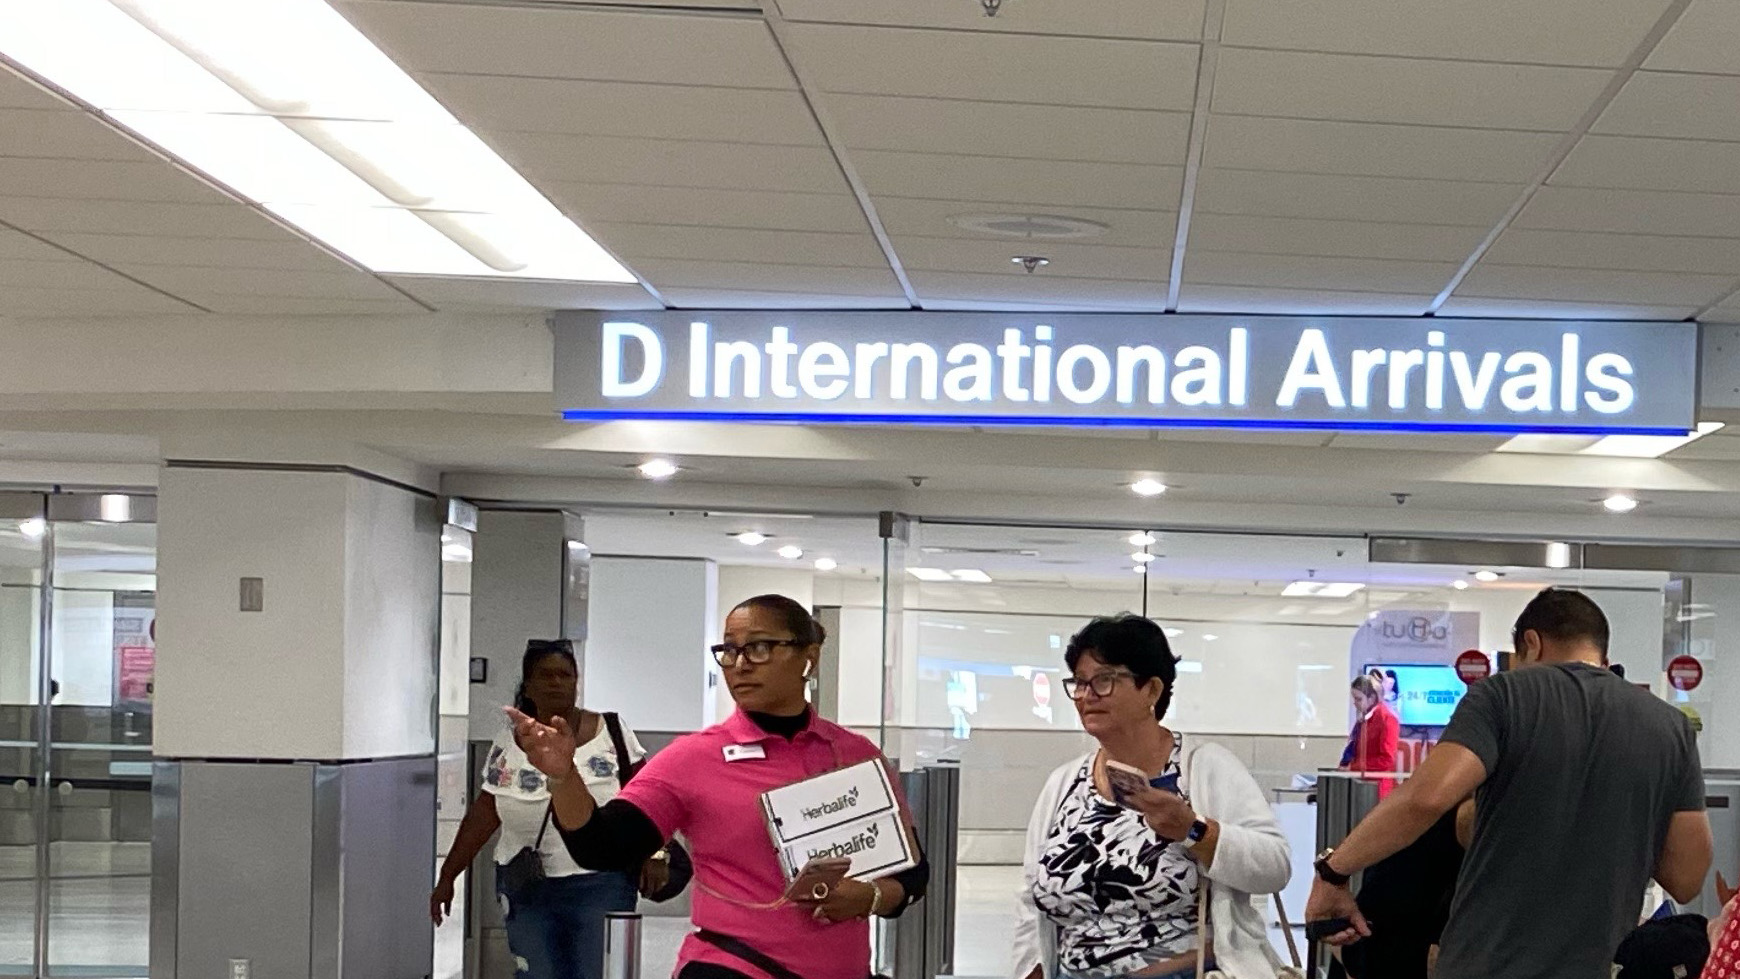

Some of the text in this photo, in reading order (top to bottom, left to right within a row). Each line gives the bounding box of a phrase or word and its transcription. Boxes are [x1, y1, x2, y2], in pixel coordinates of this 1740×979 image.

[601, 321, 1635, 413] D International Arrivals
[800, 794, 857, 821] Herbalife
